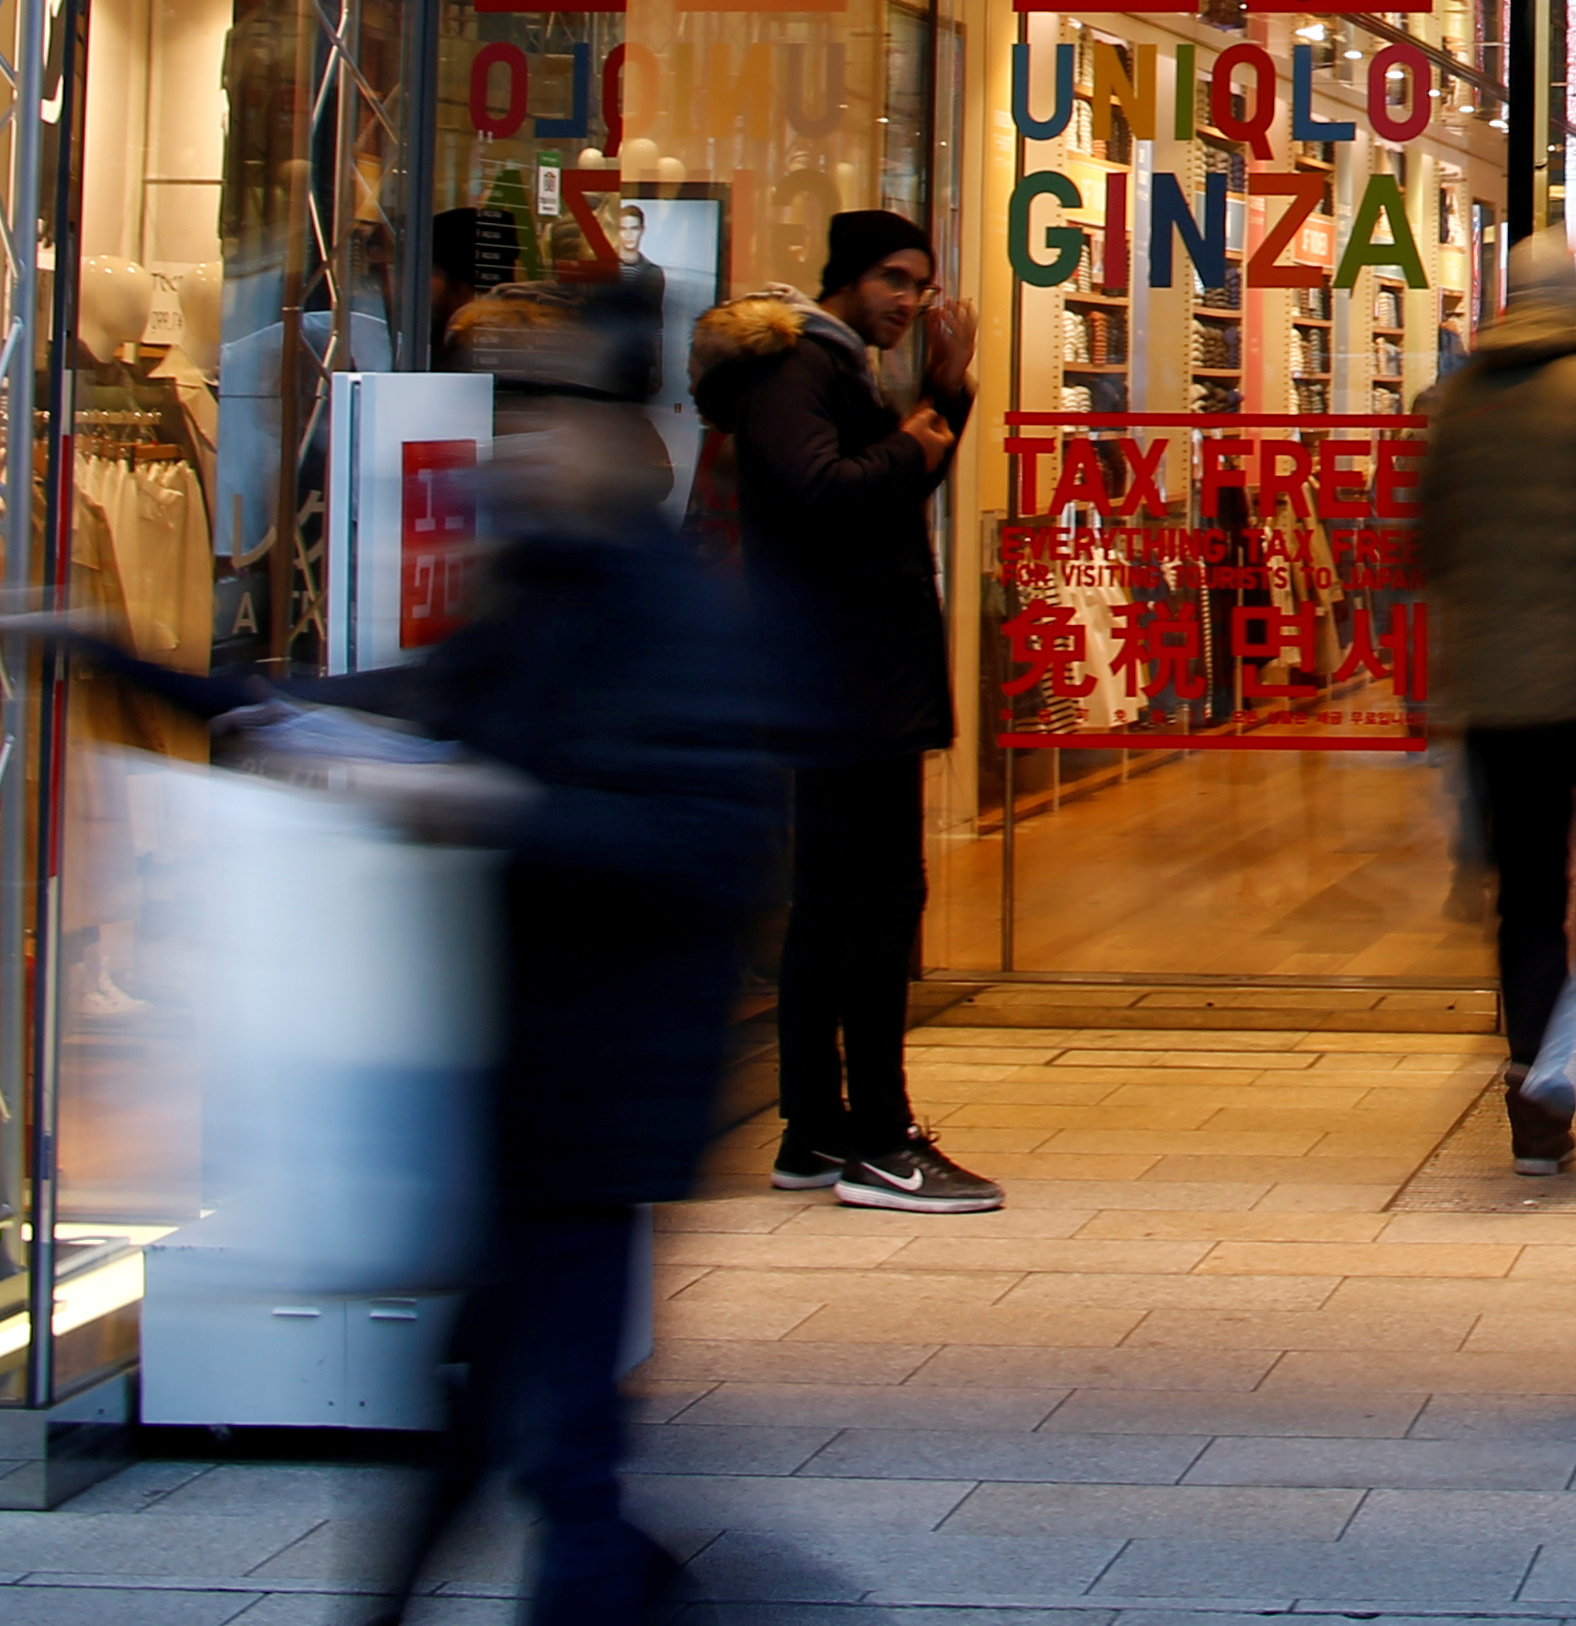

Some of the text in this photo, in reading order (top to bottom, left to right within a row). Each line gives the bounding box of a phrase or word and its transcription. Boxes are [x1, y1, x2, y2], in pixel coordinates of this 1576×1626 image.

[1011, 43, 1433, 161] UNIQLO
[1007, 170, 1429, 289] GINZA
[1004, 436, 1429, 519] TAX FREE
[1000, 526, 1423, 564] EVERYTHING TAX FREE
[1061, 564, 1161, 590] VISITING
[1174, 565, 1290, 591] TOURISTS
[1301, 566, 1333, 591] TO
[1342, 566, 1427, 591] JAPAN
[1231, 601, 1428, 702] 면세
